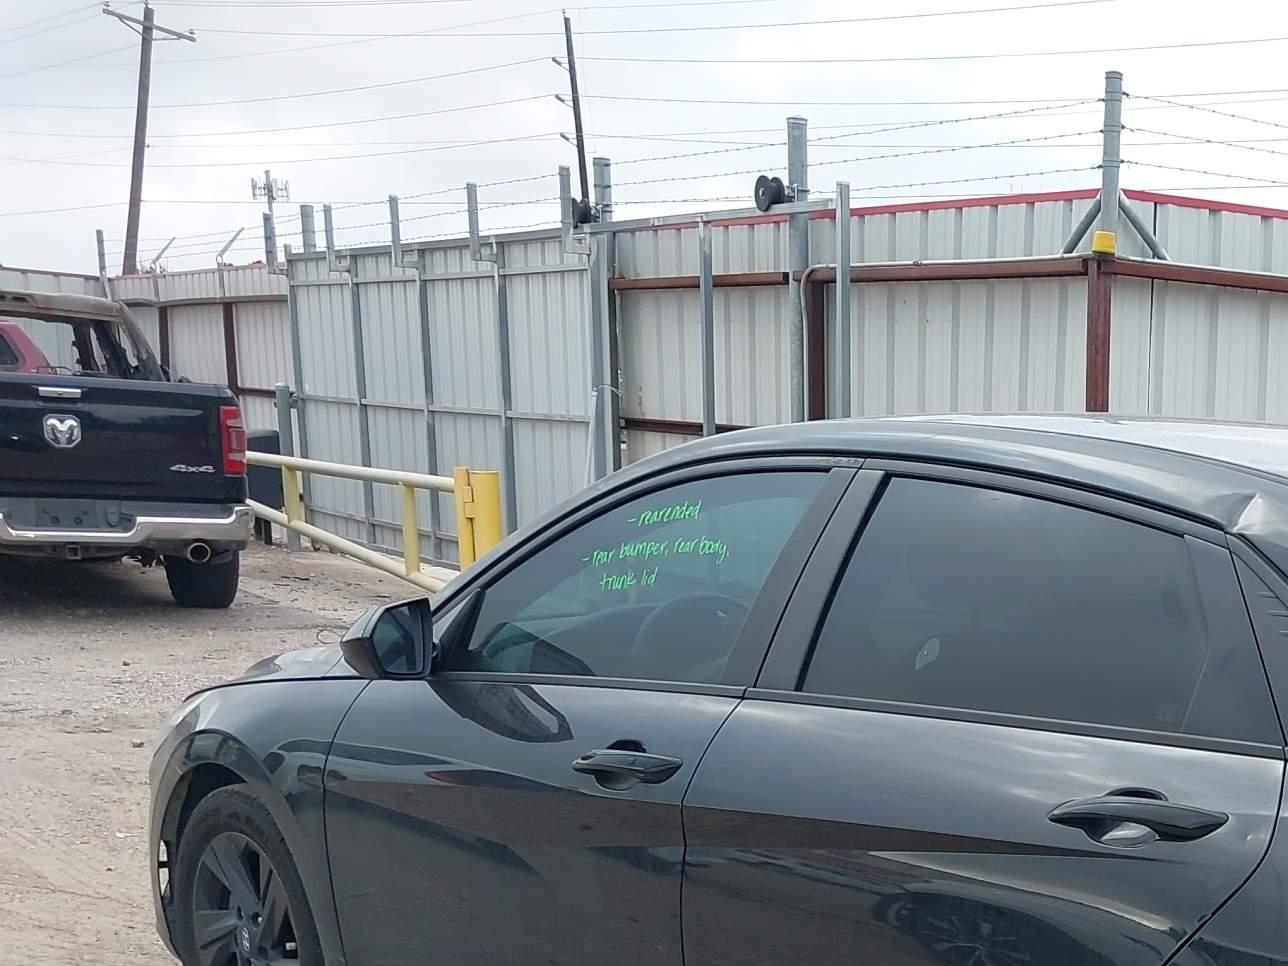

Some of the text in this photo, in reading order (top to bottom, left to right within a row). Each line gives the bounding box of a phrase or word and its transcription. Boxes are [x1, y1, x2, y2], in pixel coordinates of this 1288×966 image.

[674, 540, 697, 554] rear
[600, 566, 659, 591] trunk lid
